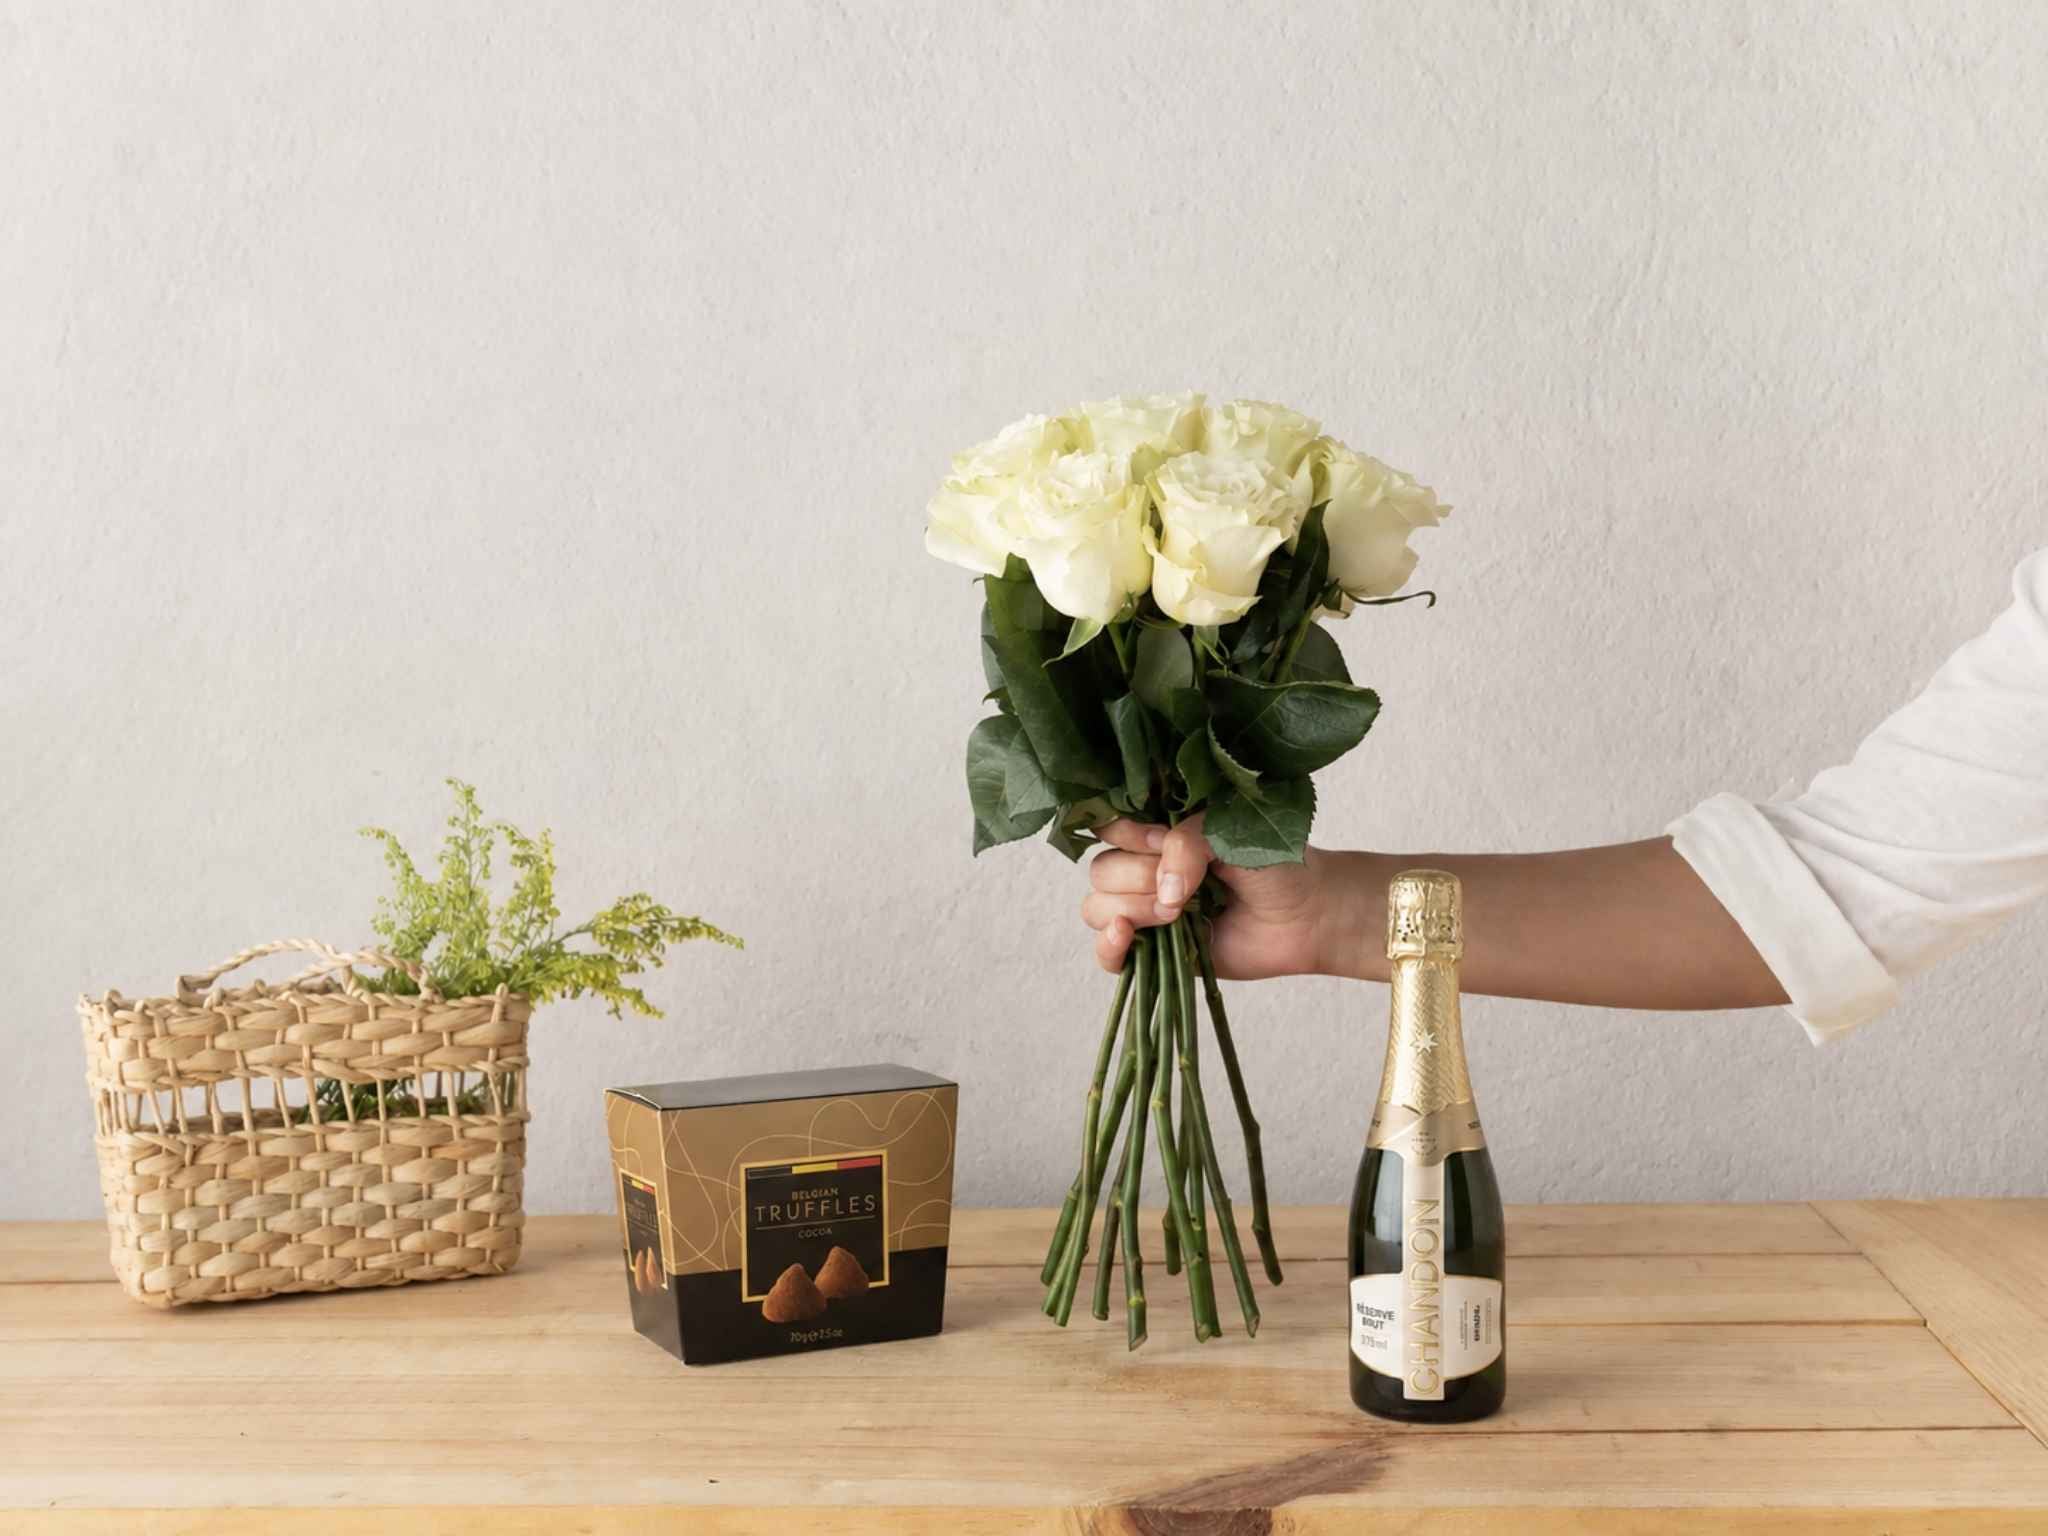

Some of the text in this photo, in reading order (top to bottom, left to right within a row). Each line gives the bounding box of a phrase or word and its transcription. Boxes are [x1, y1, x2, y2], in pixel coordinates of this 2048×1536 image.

[791, 1187, 839, 1201] BELGIAN
[755, 1194, 876, 1222] TRUFFLES
[798, 1228, 833, 1239] COCOA
[1409, 1199, 1440, 1394] CHANDON
[1362, 1316, 1385, 1330] BRUT
